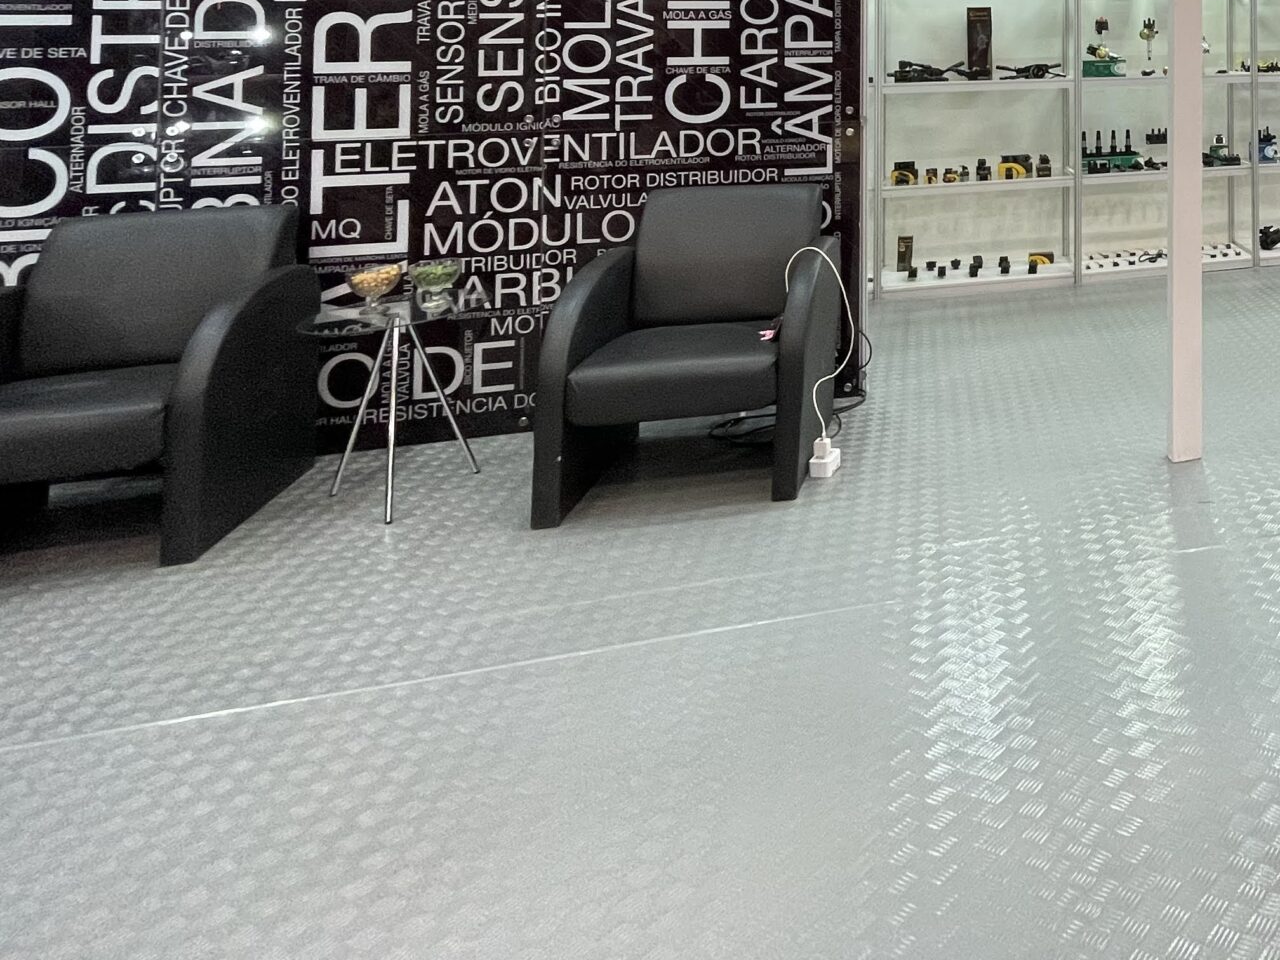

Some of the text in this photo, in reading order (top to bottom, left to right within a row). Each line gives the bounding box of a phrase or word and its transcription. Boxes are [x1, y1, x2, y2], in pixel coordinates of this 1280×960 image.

[416, 0, 431, 45] TRAVA
[663, 10, 732, 20] MOLA A GÁS
[21, 47, 88, 58] DE SETA
[435, 0, 466, 125] SENSOR
[535, 28, 562, 105] BICO
[665, 66, 732, 75] CHAVE DE SETA
[163, 37, 189, 117] CHAVE
[281, 7, 303, 181] ELETROVENTILADOR
[314, 73, 411, 84] TRAVA DE CÂMBIO
[417, 70, 430, 92] GÁS
[418, 104, 430, 134] MOLA
[461, 120, 513, 133] MÓDULO
[69, 106, 86, 194] ALTERNADOR
[334, 128, 762, 174] ELETROVENTILADOR
[764, 144, 827, 154] ALTERNADOR
[425, 175, 562, 217] ATON
[571, 174, 640, 190] ROTOR
[646, 169, 779, 188] DISTRIBUIDOR
[311, 218, 362, 240] MQ
[424, 211, 635, 257] MÓDULO
[412, 339, 516, 400] DE
